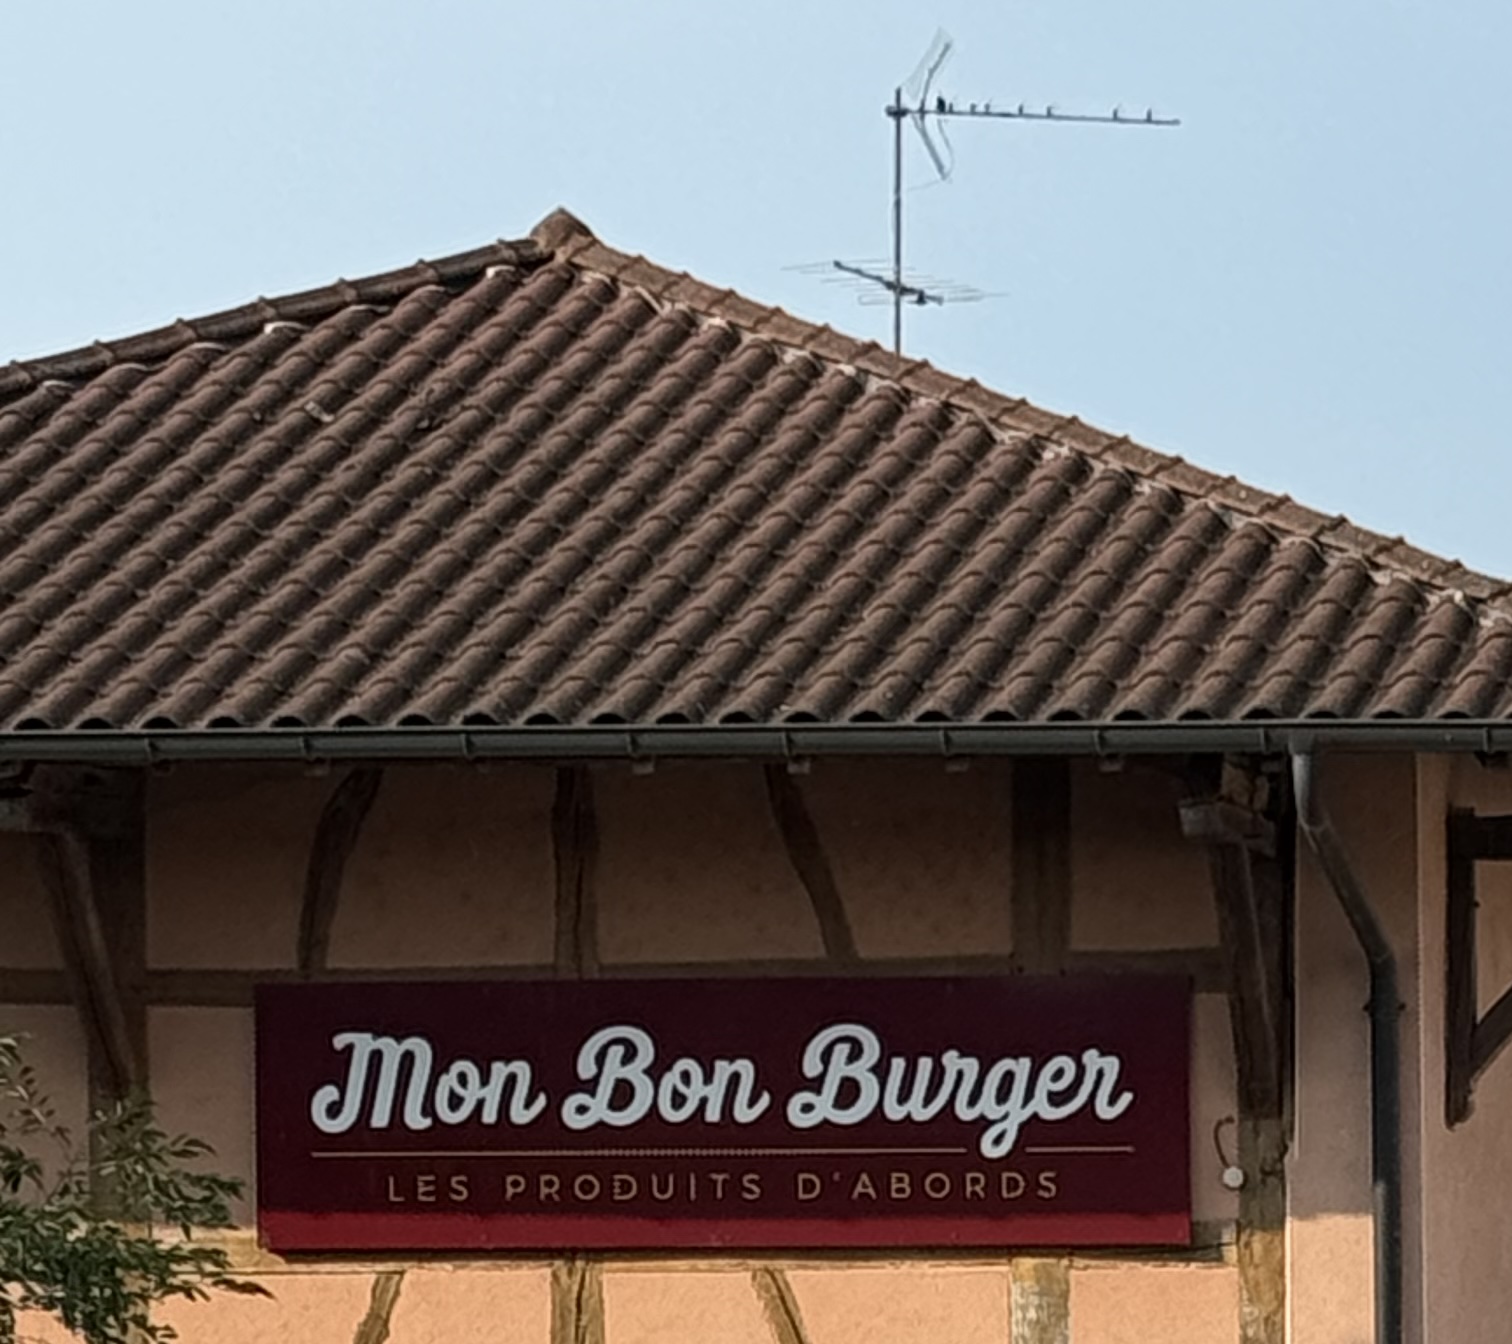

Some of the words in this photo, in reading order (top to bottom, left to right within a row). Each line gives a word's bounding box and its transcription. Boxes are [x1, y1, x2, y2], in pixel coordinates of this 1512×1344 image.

[310, 1031, 548, 1134] Mon
[560, 1024, 771, 1131] Bon
[786, 1023, 1135, 1160] Burger
[387, 1174, 469, 1203] LES
[505, 1172, 763, 1201] PRODUITS
[797, 1171, 1059, 1201] D'ABORDS
